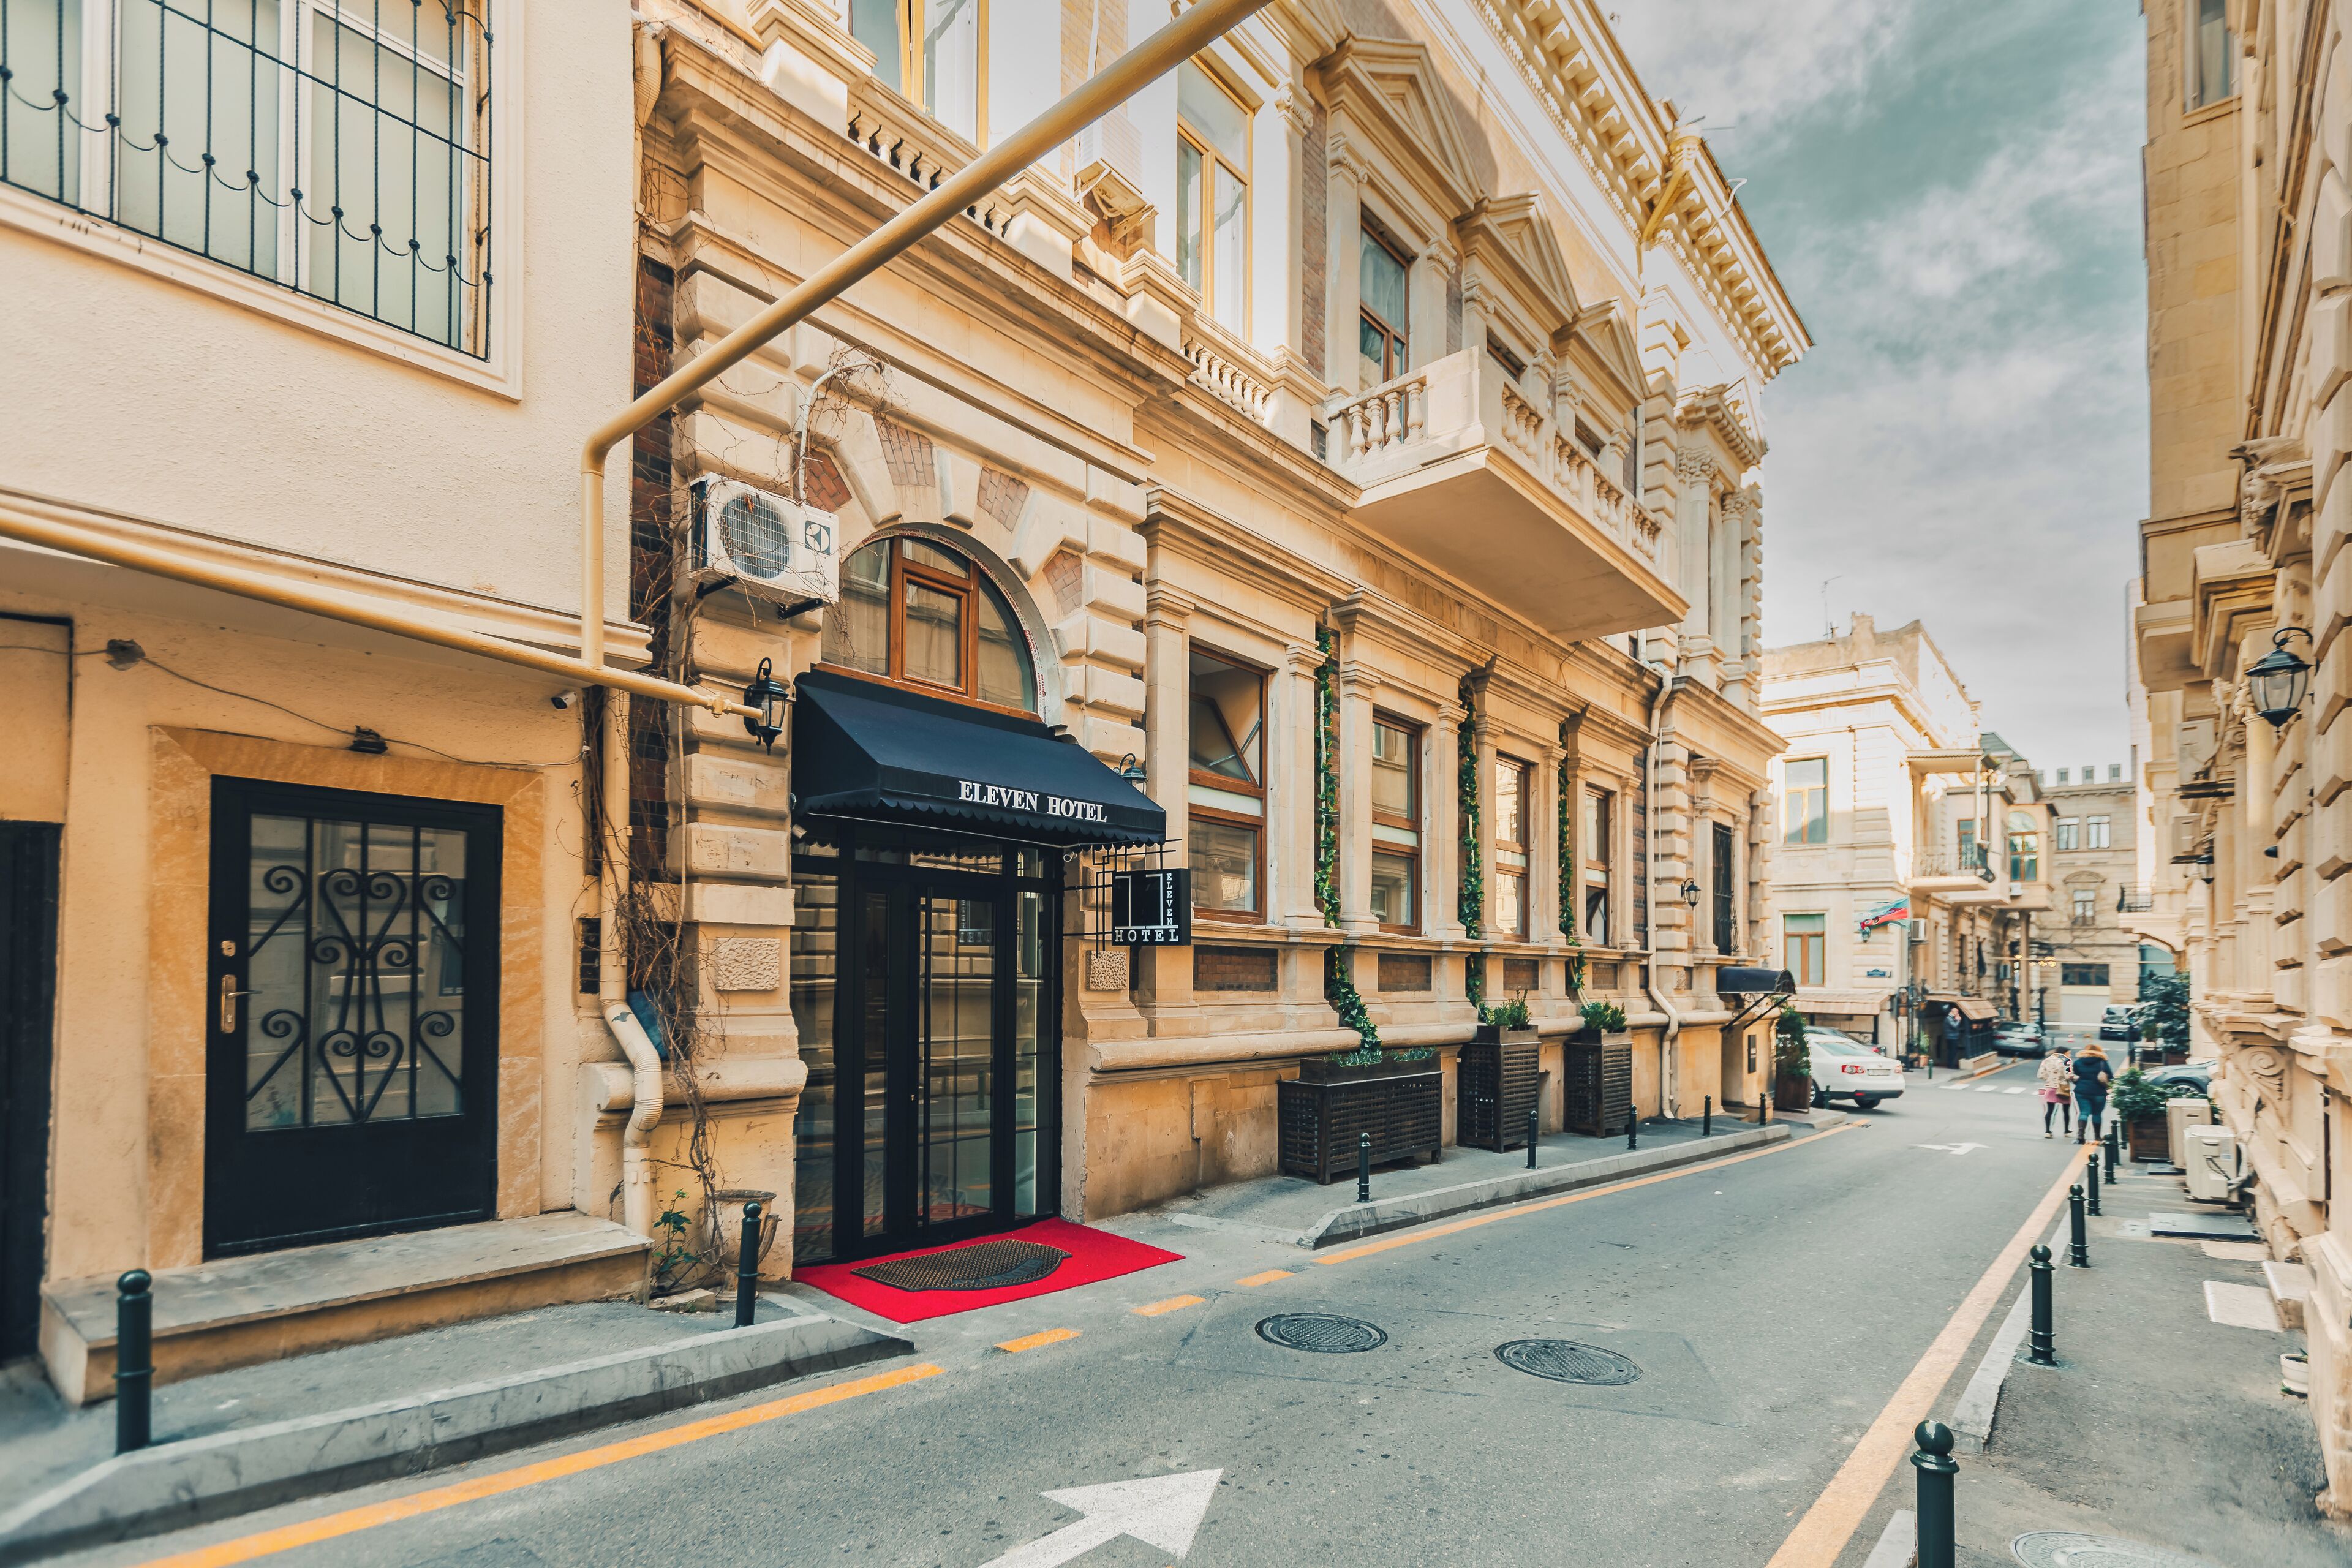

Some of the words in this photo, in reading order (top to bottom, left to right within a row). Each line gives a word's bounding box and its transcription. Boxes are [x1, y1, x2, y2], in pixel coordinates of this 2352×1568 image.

[959, 780, 1039, 812] ELEVEN
[1046, 796, 1107, 823] HOTEL
[1115, 929, 1179, 942] HOTEL
